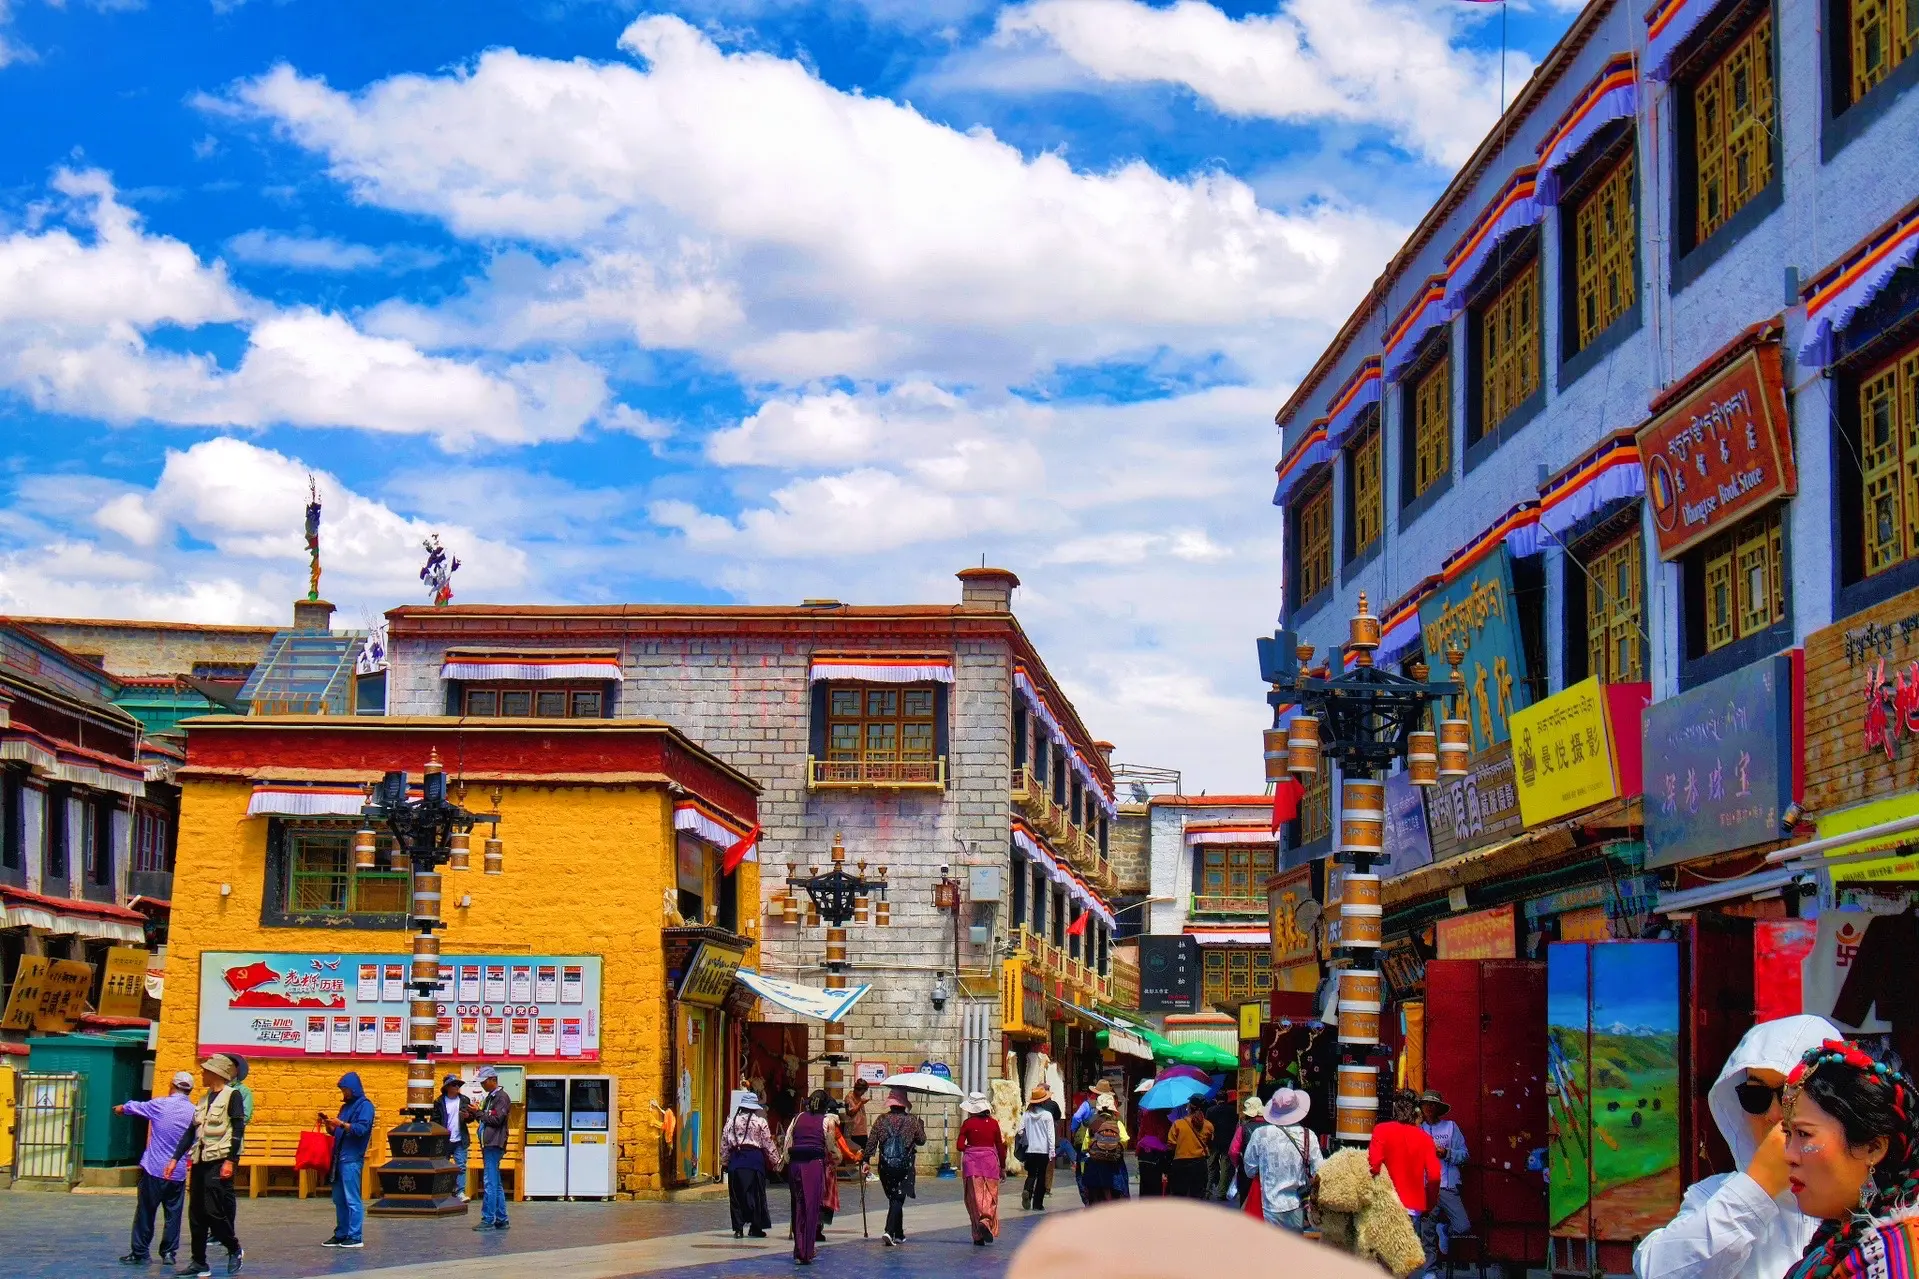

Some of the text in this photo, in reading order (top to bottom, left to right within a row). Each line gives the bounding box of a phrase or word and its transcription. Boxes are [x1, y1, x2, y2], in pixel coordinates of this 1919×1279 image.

[1718, 474, 1741, 505] Book
[1738, 467, 1765, 493] Store
[1541, 725, 1601, 776] 曼悦摄影
[284, 968, 344, 992] 光辉历程
[457, 1006, 492, 1015] 知党情
[503, 1006, 539, 1015] 跟党走
[251, 1018, 293, 1030] 不忘初心
[258, 1031, 301, 1043] 牢记使命
